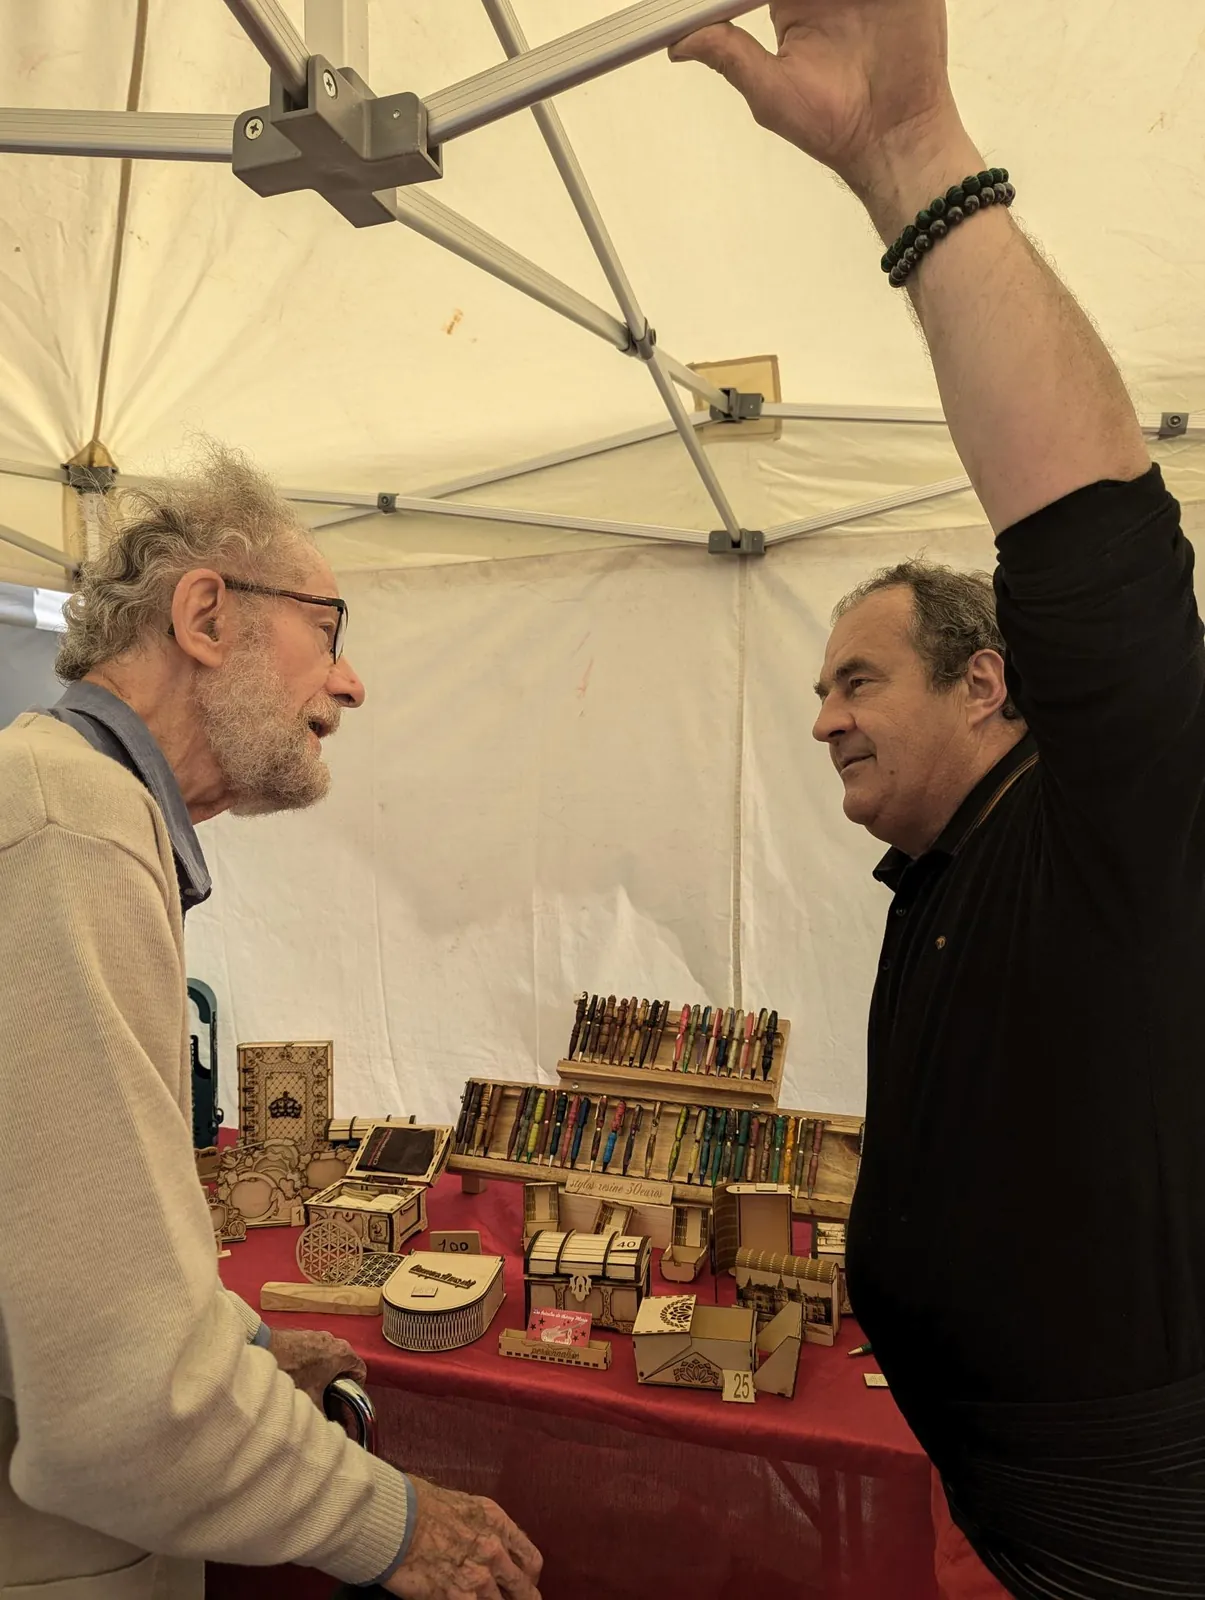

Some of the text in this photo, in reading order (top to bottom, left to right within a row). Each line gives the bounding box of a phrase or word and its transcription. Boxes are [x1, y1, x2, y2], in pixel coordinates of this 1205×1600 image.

[569, 1176, 595, 1193] stylos
[438, 1239, 469, 1252] 100
[733, 1373, 750, 1399] 25
